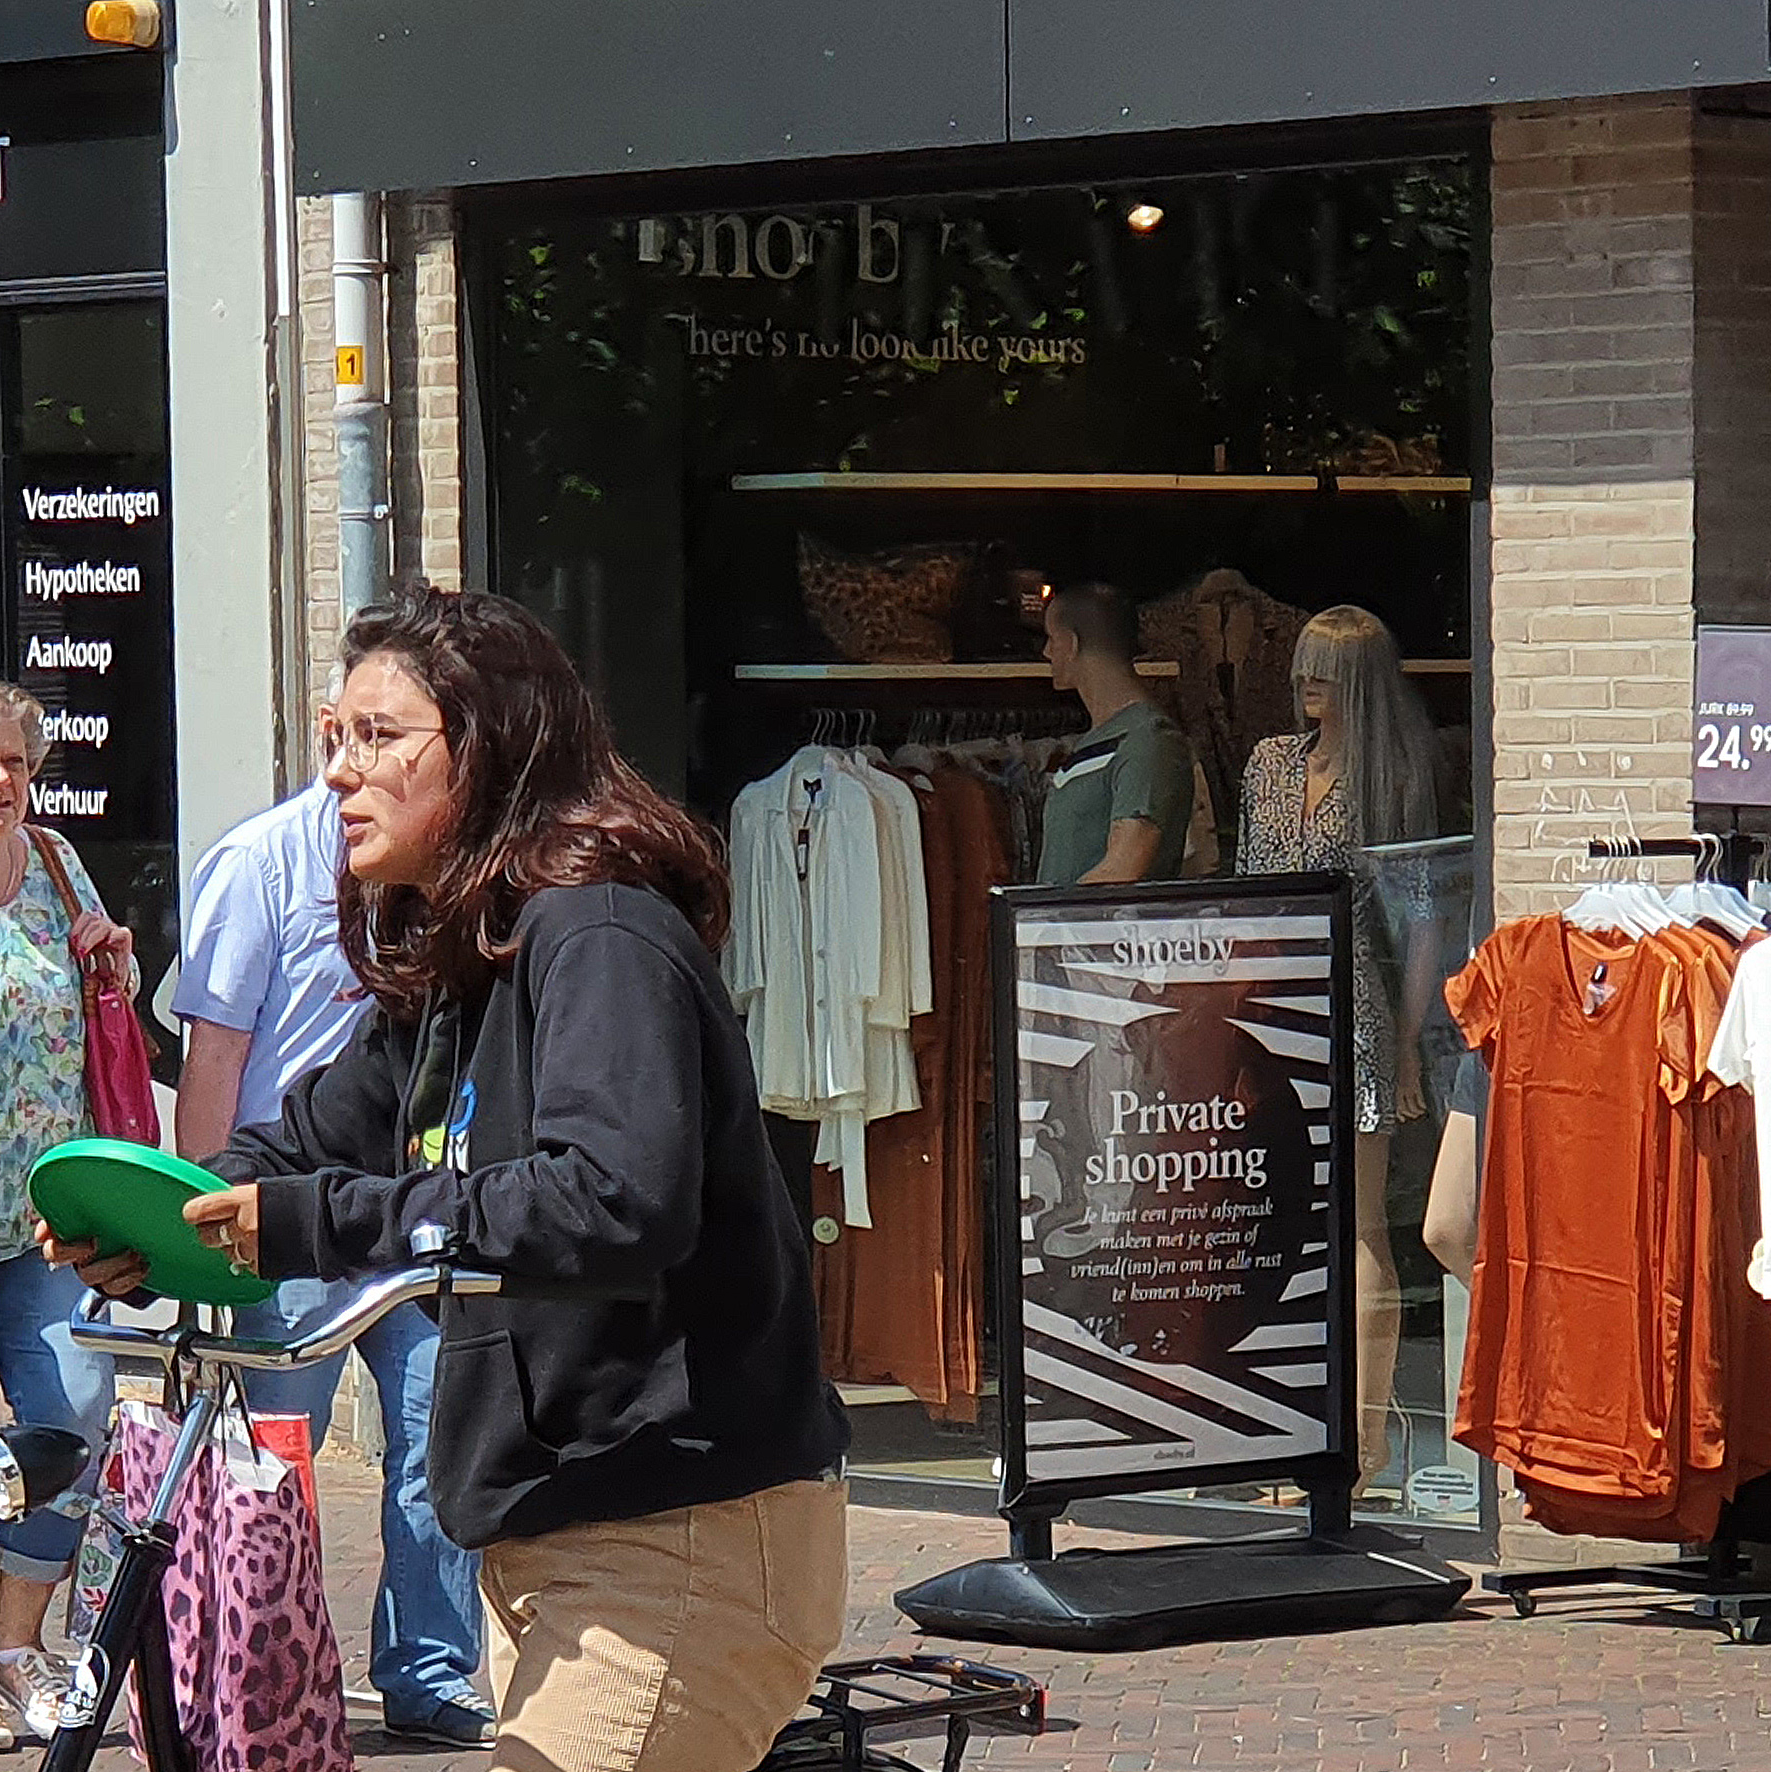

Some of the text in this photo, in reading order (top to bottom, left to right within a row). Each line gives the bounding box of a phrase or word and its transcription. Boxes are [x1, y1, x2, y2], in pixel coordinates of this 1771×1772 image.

[23, 486, 159, 524] Verzekeringen
[25, 561, 141, 601] Hypotheken
[26, 635, 112, 674] Aankoop
[39, 710, 109, 748] erkoop
[30, 782, 108, 815] Verhuur
[1112, 924, 1234, 975] shoeby
[1109, 1090, 1246, 1134] Private
[1085, 1137, 1267, 1193] shopping
[1140, 1208, 1167, 1223] een
[1211, 1197, 1273, 1223] afspraak
[1100, 1224, 1260, 1250] maken met je gezin of
[1070, 1256, 1177, 1280] vriend(inn)en
[1180, 1260, 1204, 1274] om
[1207, 1255, 1223, 1272] in
[1112, 1286, 1127, 1303] te
[1130, 1281, 1180, 1303] komen
